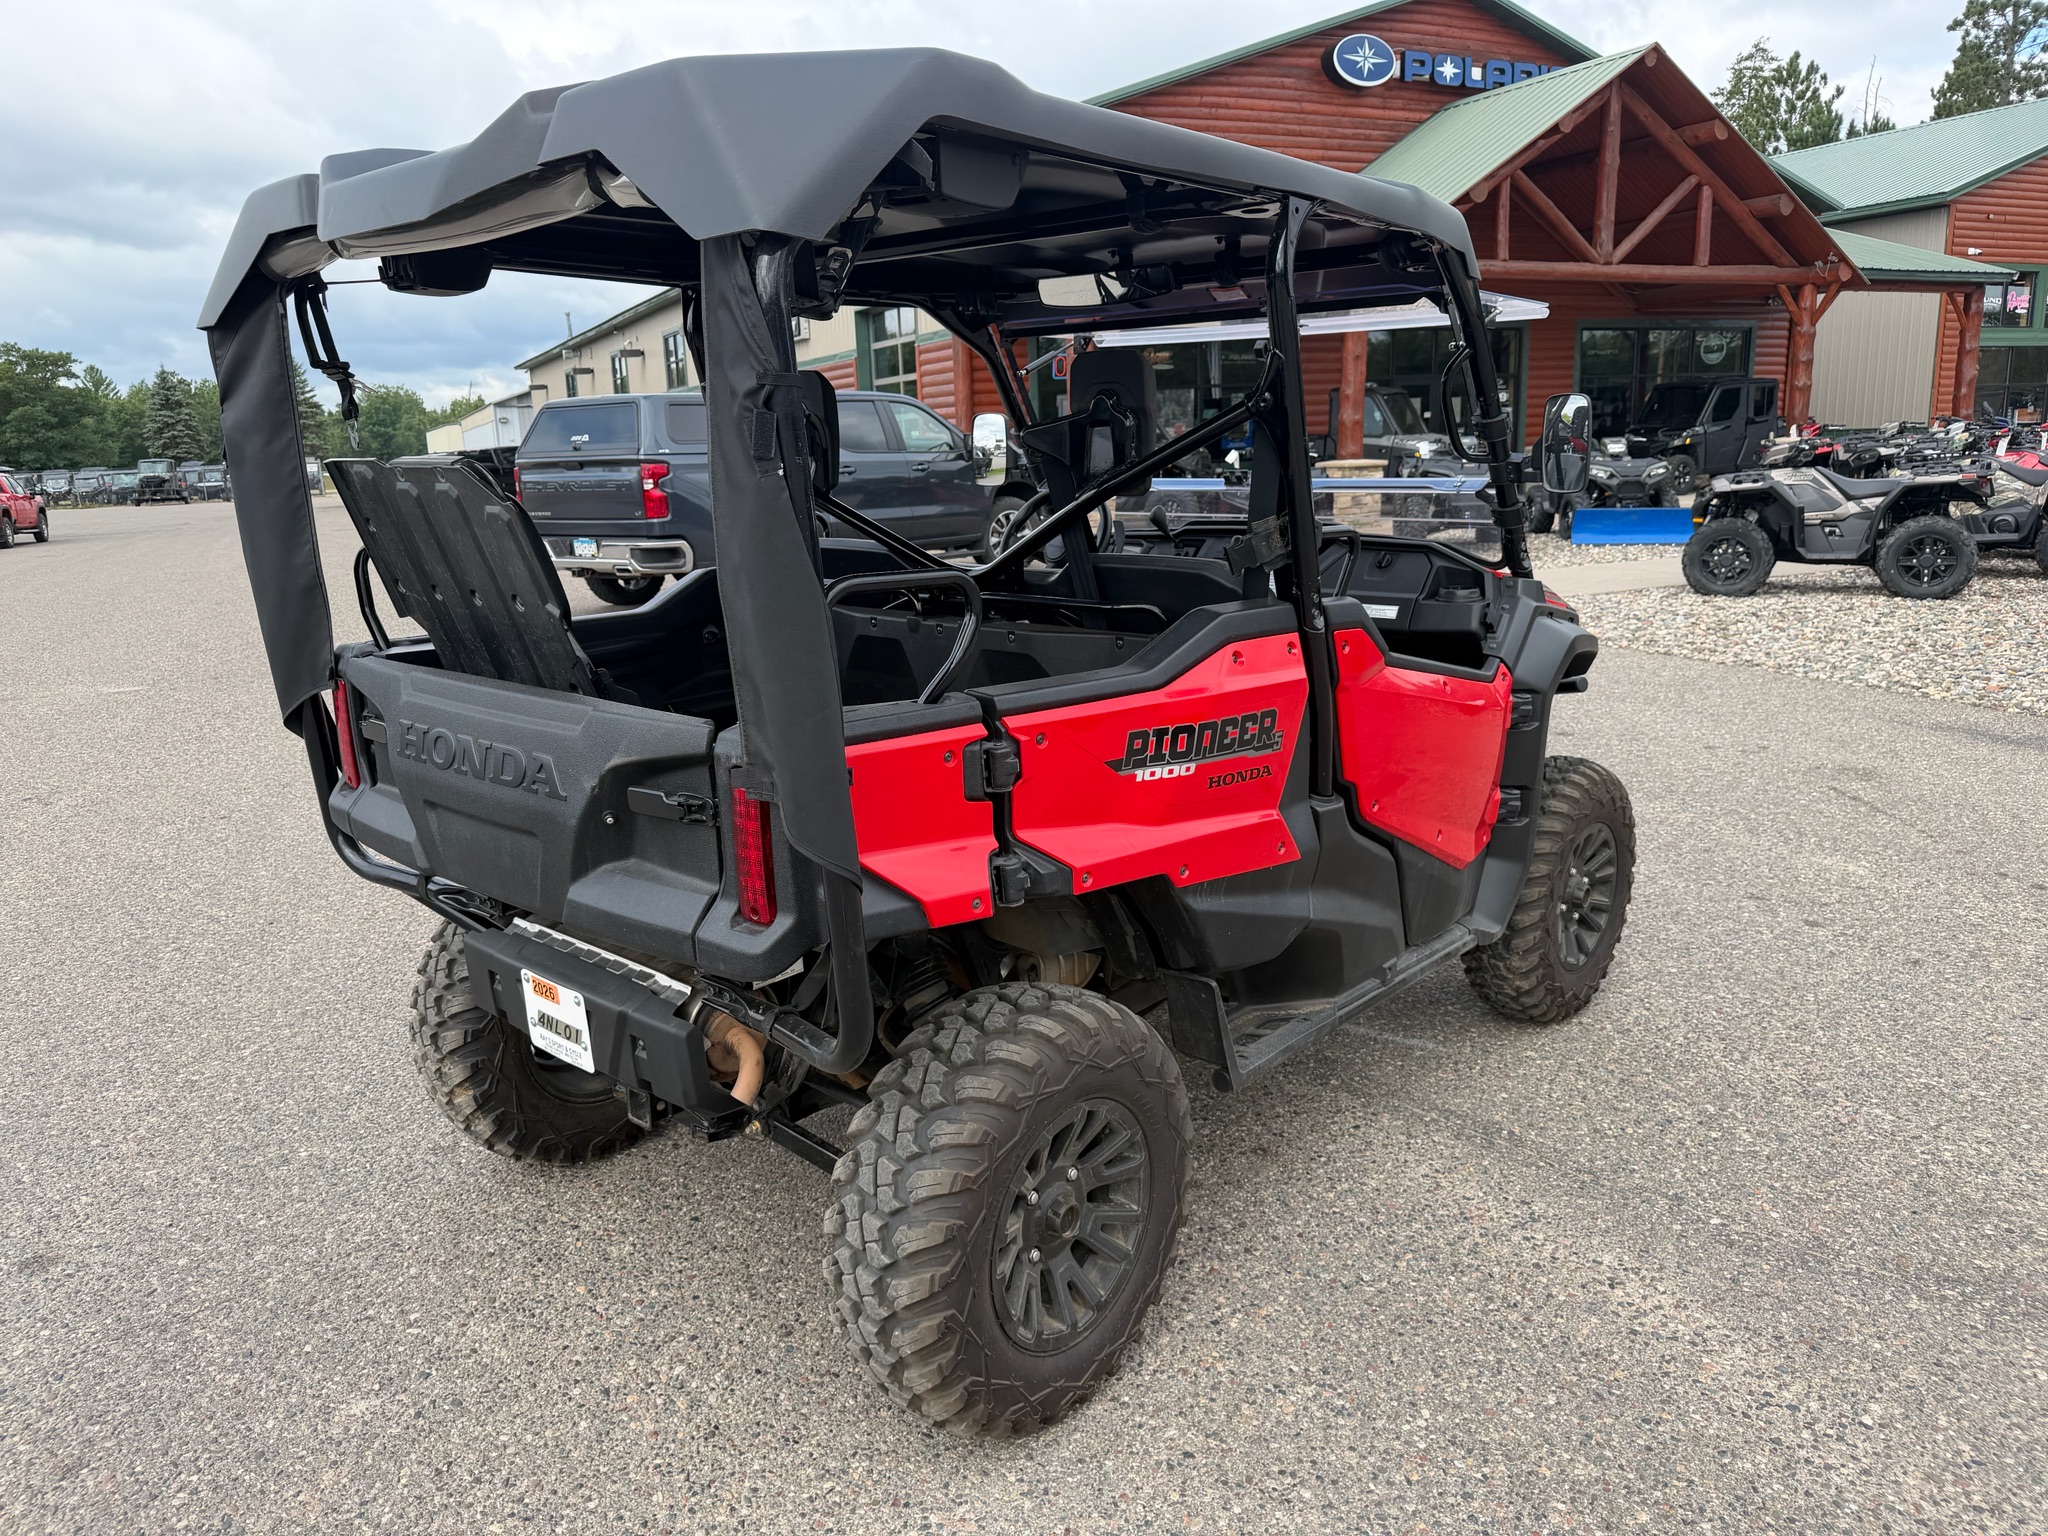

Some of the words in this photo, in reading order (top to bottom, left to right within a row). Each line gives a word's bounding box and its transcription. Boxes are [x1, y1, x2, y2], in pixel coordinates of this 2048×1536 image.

[1403, 50, 1564, 90] POLAR
[525, 480, 630, 492] CHEVROLET
[397, 718, 568, 801] HONDA
[1134, 762, 1196, 782] 1000
[1206, 764, 1272, 789] HONDA
[532, 979, 555, 1001] 2026
